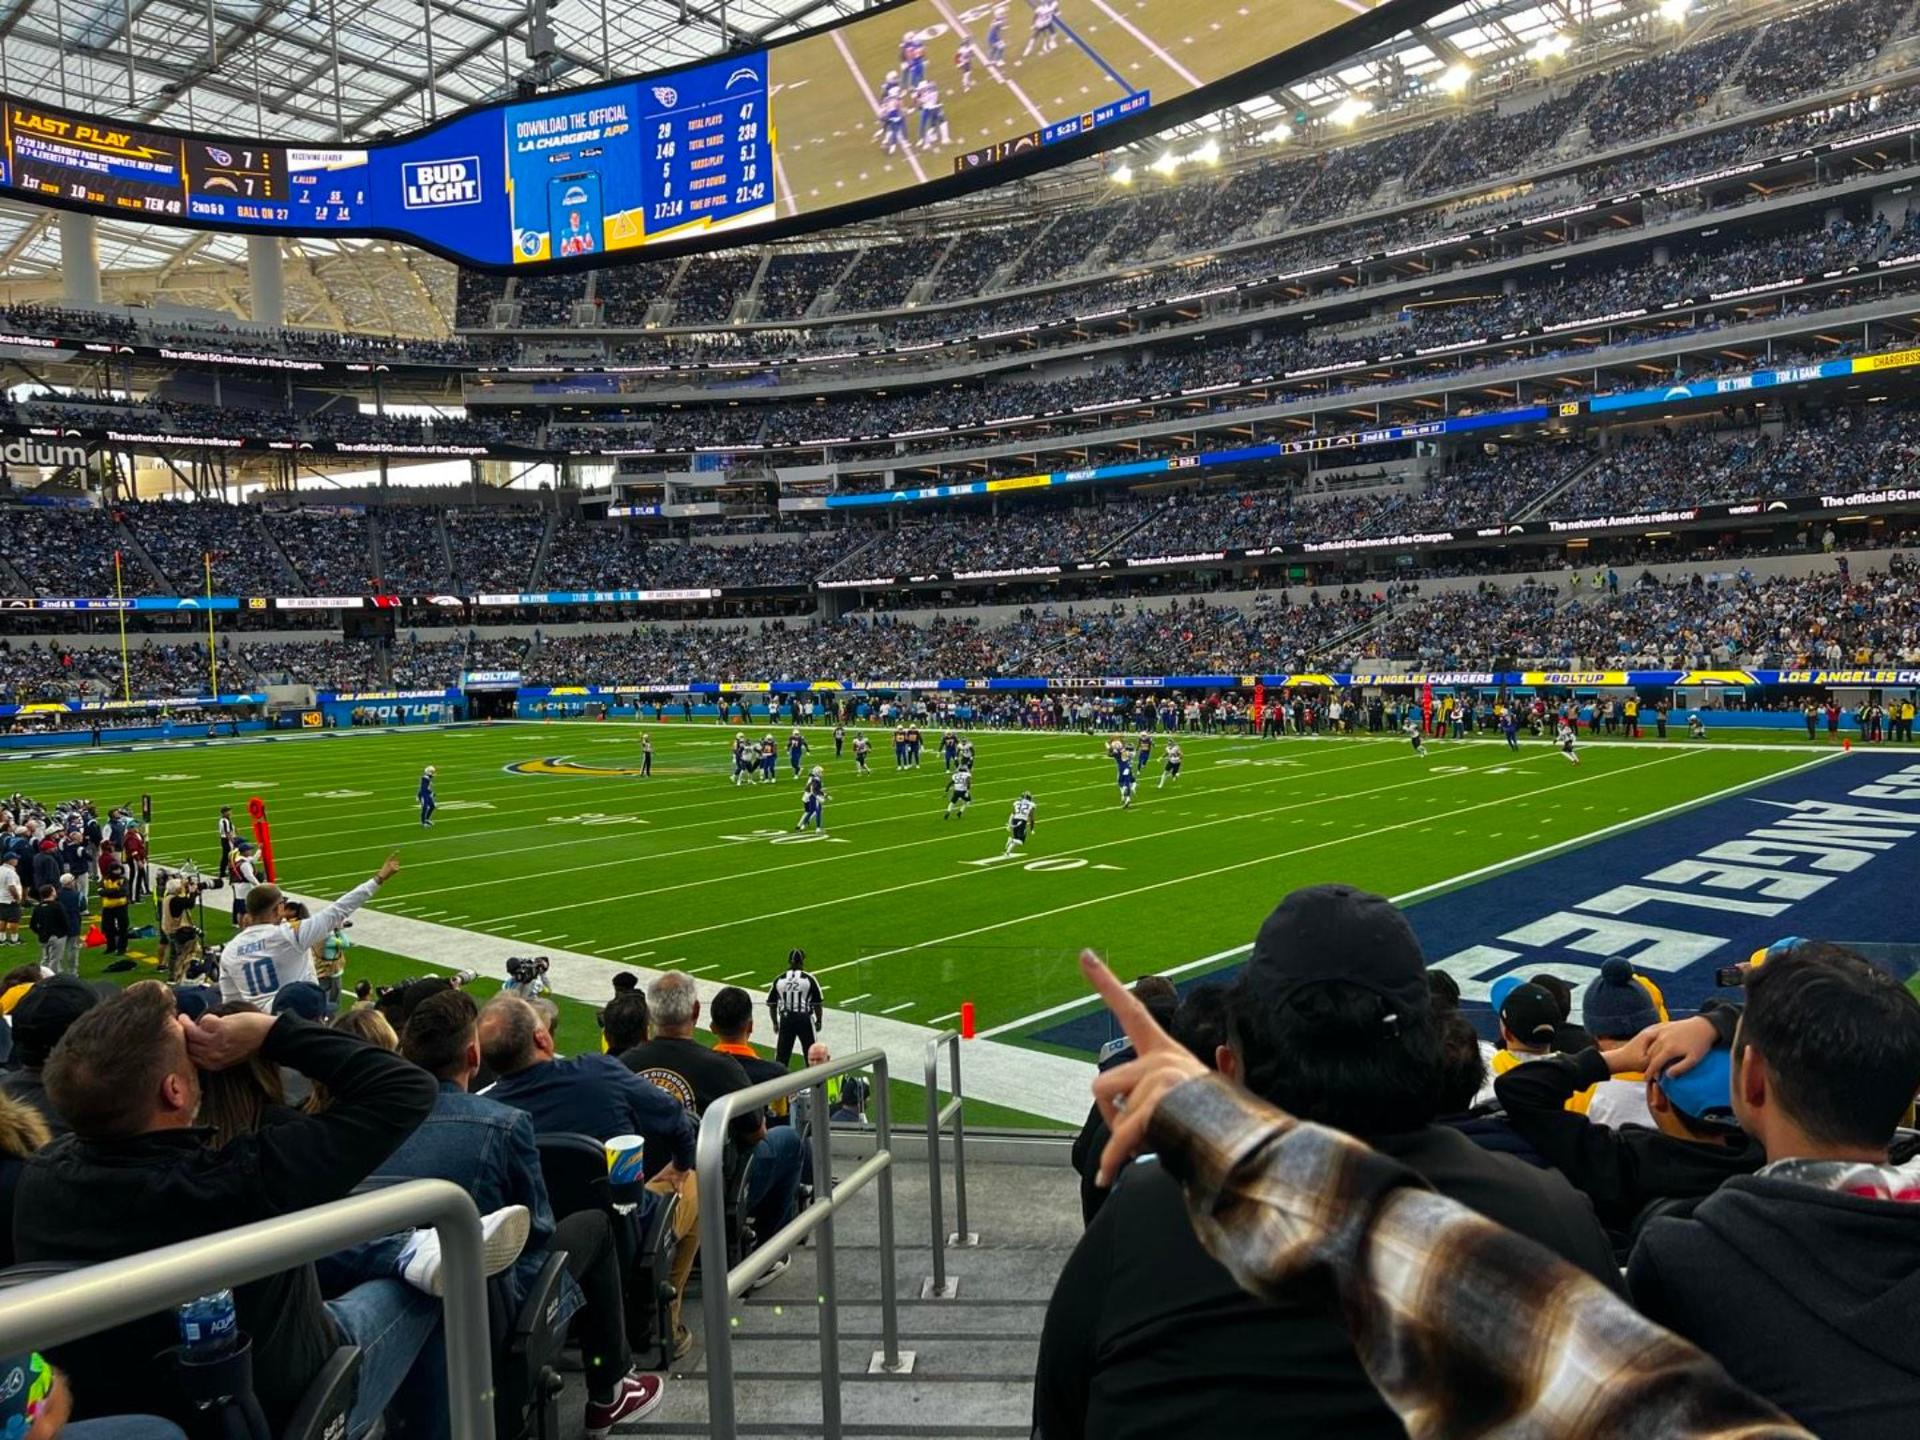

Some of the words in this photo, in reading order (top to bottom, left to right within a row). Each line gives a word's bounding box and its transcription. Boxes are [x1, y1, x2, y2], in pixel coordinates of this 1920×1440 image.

[14, 111, 70, 134] LAST
[76, 126, 130, 147] PLAY
[516, 115, 568, 139] DOWNLOAD
[570, 112, 587, 129] THE
[589, 104, 628, 126] OFFICIAL
[518, 138, 536, 152] LA
[536, 129, 600, 150] CHARGERS
[603, 123, 629, 139] APP
[242, 152, 252, 169] 7
[417, 163, 467, 185] BUD
[22, 174, 39, 190] 1ST
[71, 184, 86, 199] 10
[144, 197, 165, 212] TEN
[166, 200, 181, 214] 48
[244, 179, 254, 196] 7
[408, 180, 477, 205] LIGHT
[276, 209, 289, 221] 27
[654, 200, 683, 219] 17:14
[160, 349, 179, 359] The
[179, 351, 208, 361] official
[222, 355, 258, 366] network
[259, 358, 269, 366] of
[269, 359, 283, 367] the
[107, 431, 126, 441] The
[127, 433, 165, 443] network
[165, 435, 203, 445] America
[204, 437, 229, 446] relies
[0, 437, 87, 466] dium
[336, 443, 353, 452] The
[353, 443, 380, 452] official
[394, 444, 426, 453] network
[1821, 496, 1844, 508] The
[1845, 492, 1886, 506] official
[1888, 490, 1907, 501] 5G
[1549, 521, 1567, 532] The
[1568, 517, 1607, 530] network
[1608, 513, 1649, 526] America
[1651, 510, 1678, 522] relies
[1679, 511, 1694, 520] on
[1303, 543, 1317, 552] The
[1319, 541, 1344, 550] official
[1357, 538, 1389, 548] network
[1350, 673, 1371, 684] LOS
[1375, 673, 1426, 684] ANGELES
[1428, 673, 1493, 684] CHARGERS
[1779, 672, 1810, 683] LOS
[1813, 671, 1896, 684] ANGELES
[81, 702, 100, 710] LOS
[1015, 803, 1030, 815] 32
[241, 957, 279, 996] 10
[786, 982, 800, 991] 72
